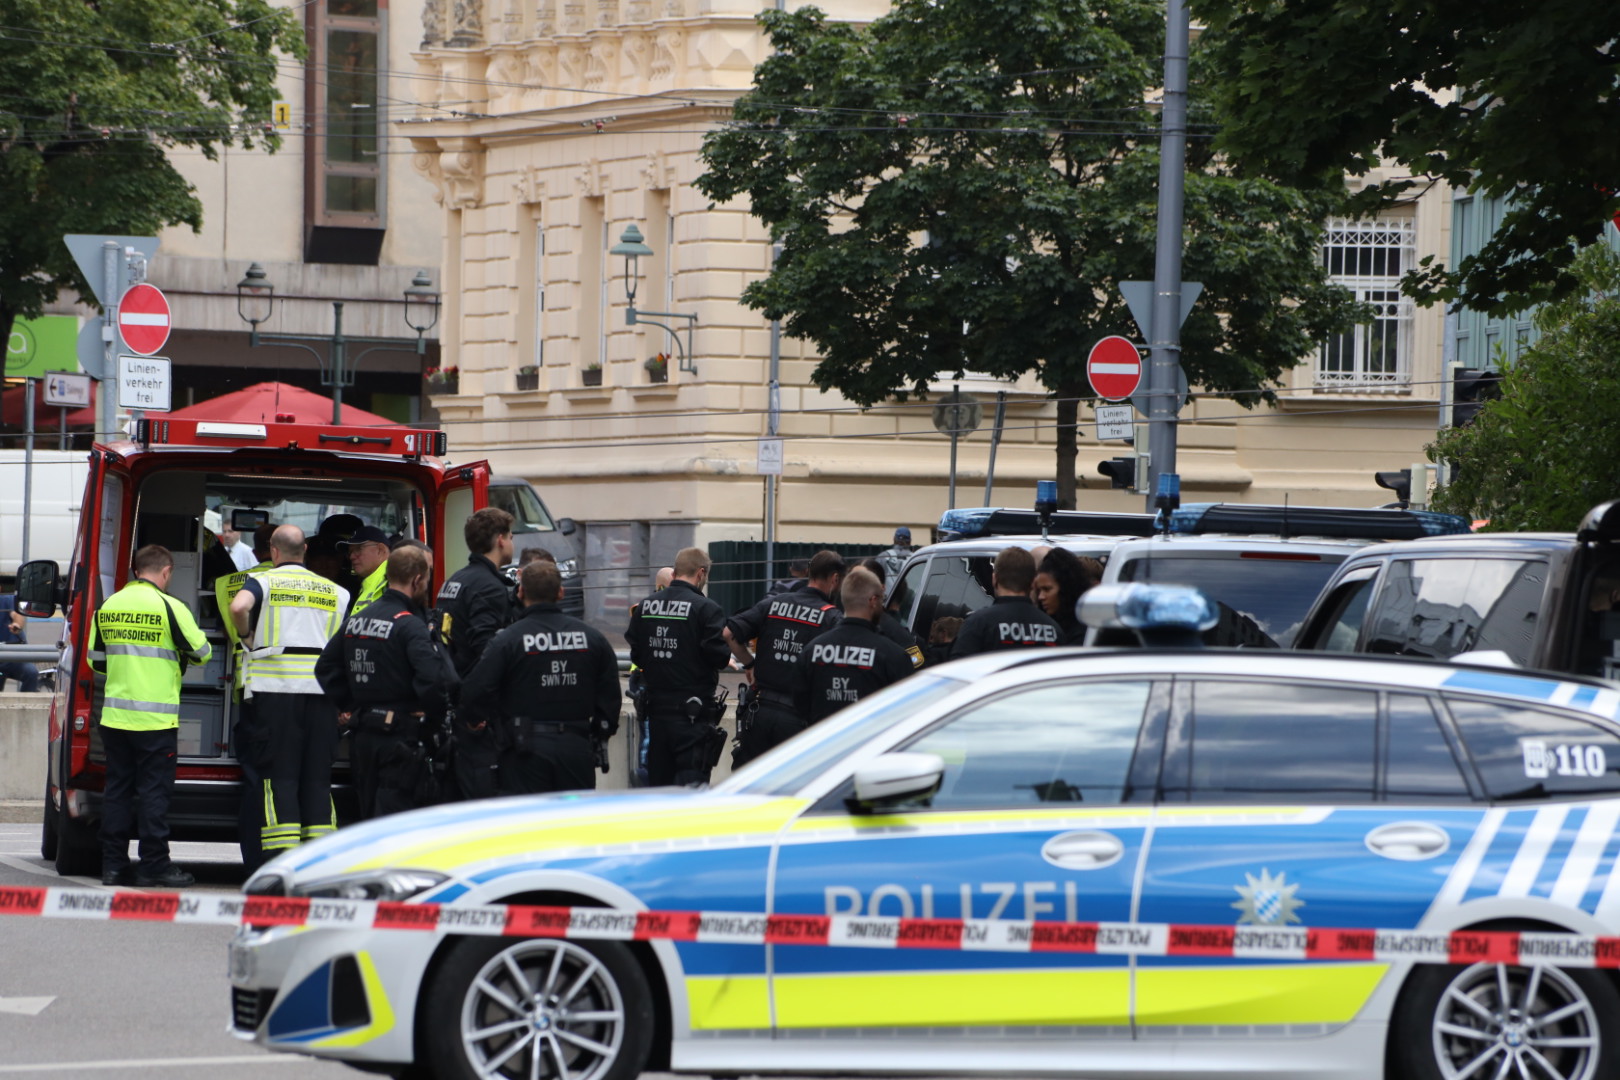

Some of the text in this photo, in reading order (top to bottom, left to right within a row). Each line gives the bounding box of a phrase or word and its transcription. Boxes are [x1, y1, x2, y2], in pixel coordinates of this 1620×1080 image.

[128, 362, 161, 375] Linien-
[126, 378, 163, 390] verkehr
[136, 391, 153, 403] frei
[1103, 410, 1127, 418] Linien-
[270, 593, 336, 608] FEUERWEHR AUGSBURG
[641, 600, 692, 617] POLIZEI
[769, 601, 825, 624] POLIZEI
[99, 612, 162, 626] EINSATZLEITER
[101, 628, 162, 642] RETTUNGSDIENST
[345, 617, 394, 639] POLIZEI
[656, 626, 670, 637] BY
[783, 629, 798, 640] BY
[998, 622, 1058, 642] POLIZEI
[523, 631, 588, 652] POLIZEI
[649, 637, 678, 650] SWN 7135
[773, 639, 789, 651] SWN
[355, 648, 368, 661] BY
[811, 644, 876, 667] POLIZEI
[350, 661, 362, 672] SWN
[551, 660, 568, 674] BY
[541, 673, 577, 687] SWN 7113
[832, 677, 850, 690] BY
[826, 689, 842, 701] SWN
[1556, 744, 1606, 777] 110
[824, 881, 1079, 922] POLIZEI
